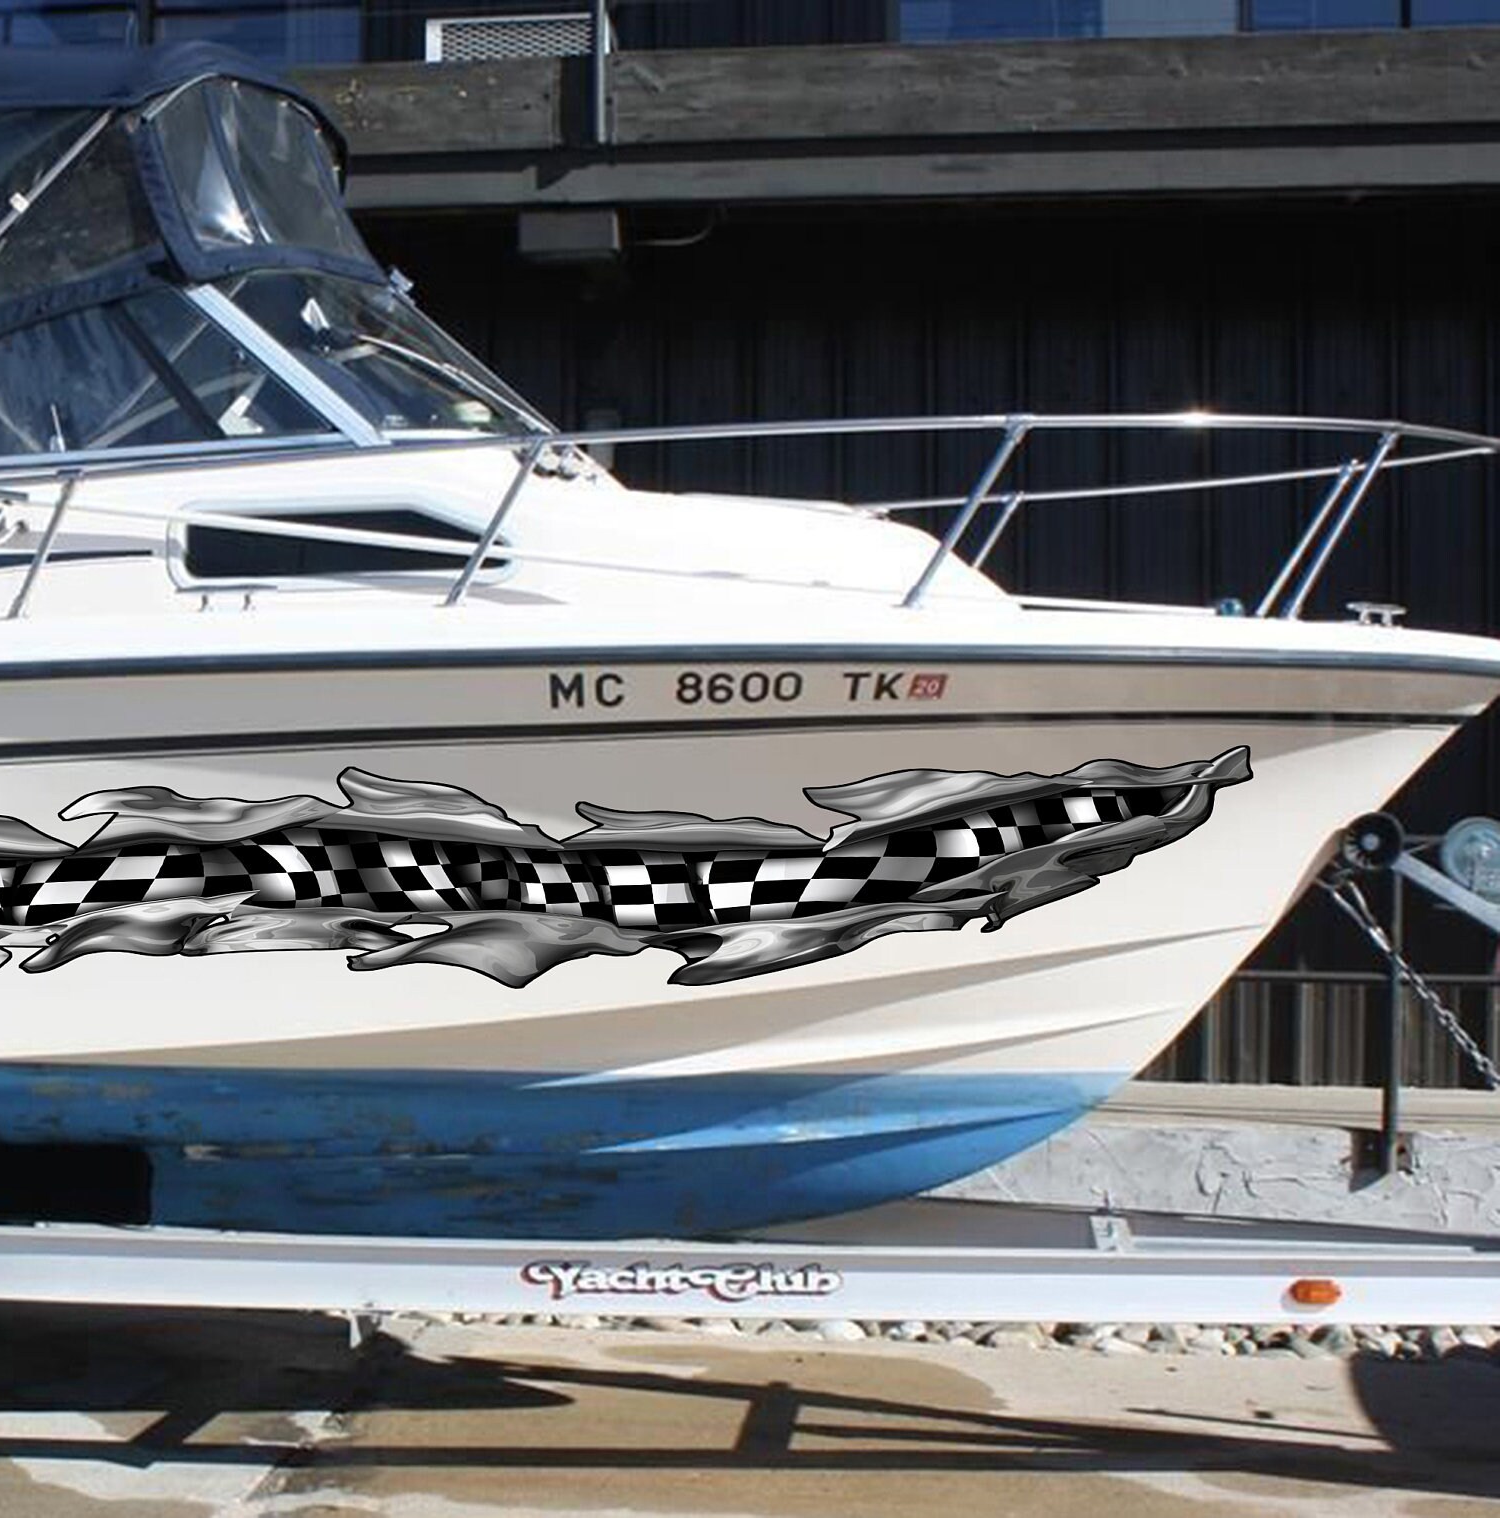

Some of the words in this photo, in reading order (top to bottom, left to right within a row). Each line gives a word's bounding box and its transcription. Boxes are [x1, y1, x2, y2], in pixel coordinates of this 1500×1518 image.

[549, 672, 625, 708] MC
[675, 671, 803, 704] 8600
[842, 671, 905, 702] TK
[520, 1260, 688, 1300] Yacht
[690, 1262, 842, 1303] Club
